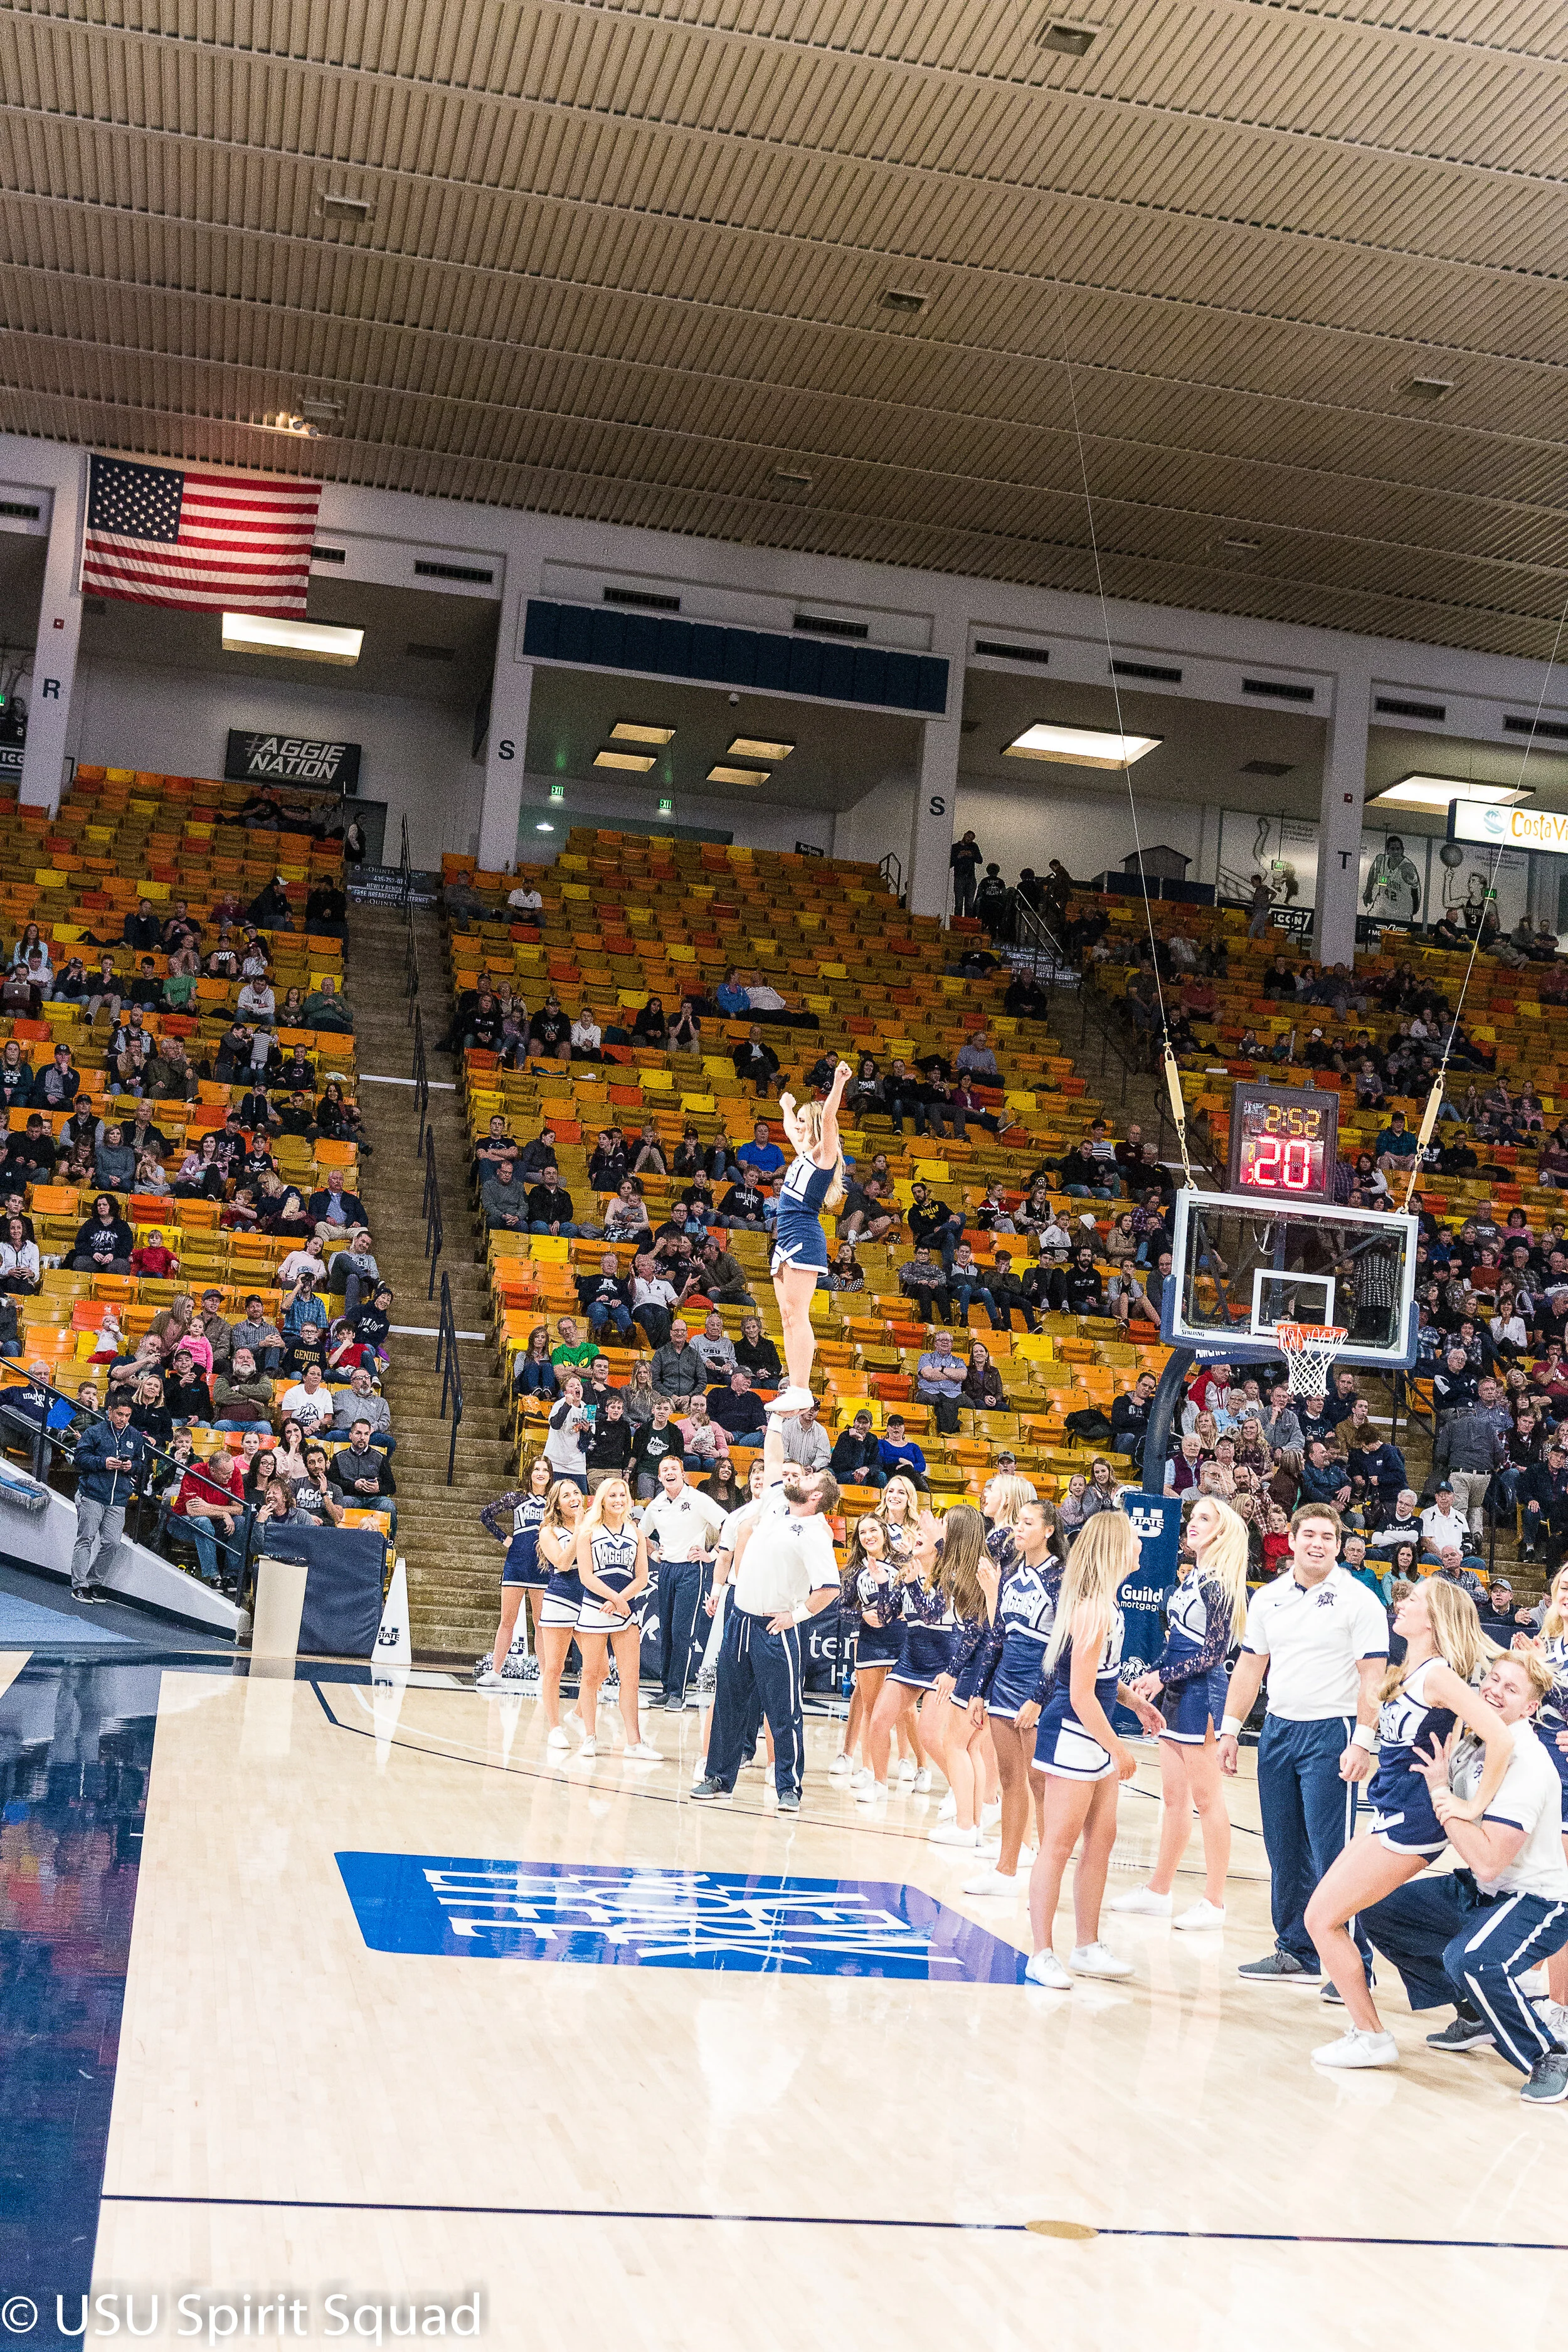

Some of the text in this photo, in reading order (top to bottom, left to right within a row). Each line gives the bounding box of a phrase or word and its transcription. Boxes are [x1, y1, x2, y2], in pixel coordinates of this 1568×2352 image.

[42, 678, 61, 699] R
[499, 740, 515, 760] S
[249, 753, 339, 780] NATION
[551, 785, 564, 795] EXIT
[659, 800, 672, 808] EXIT
[930, 797, 945, 816] S
[1338, 851, 1352, 869] T
[368, 891, 397, 901] BREAKFAST
[1470, 915, 1477, 924] 3
[1264, 1105, 1320, 1137] 2:52
[1254, 1136, 1311, 1190] 20
[735, 1192, 747, 1200] UTAH
[294, 1348, 320, 1362] GENIUS
[524, 1507, 544, 1521] AGGI
[1130, 1515, 1164, 1529] STATE
[600, 1547, 635, 1567] AGGIES
[1121, 1584, 1163, 1604] Guild
[1120, 1600, 1160, 1612] mortgag
[378, 1632, 400, 1641] STATE
